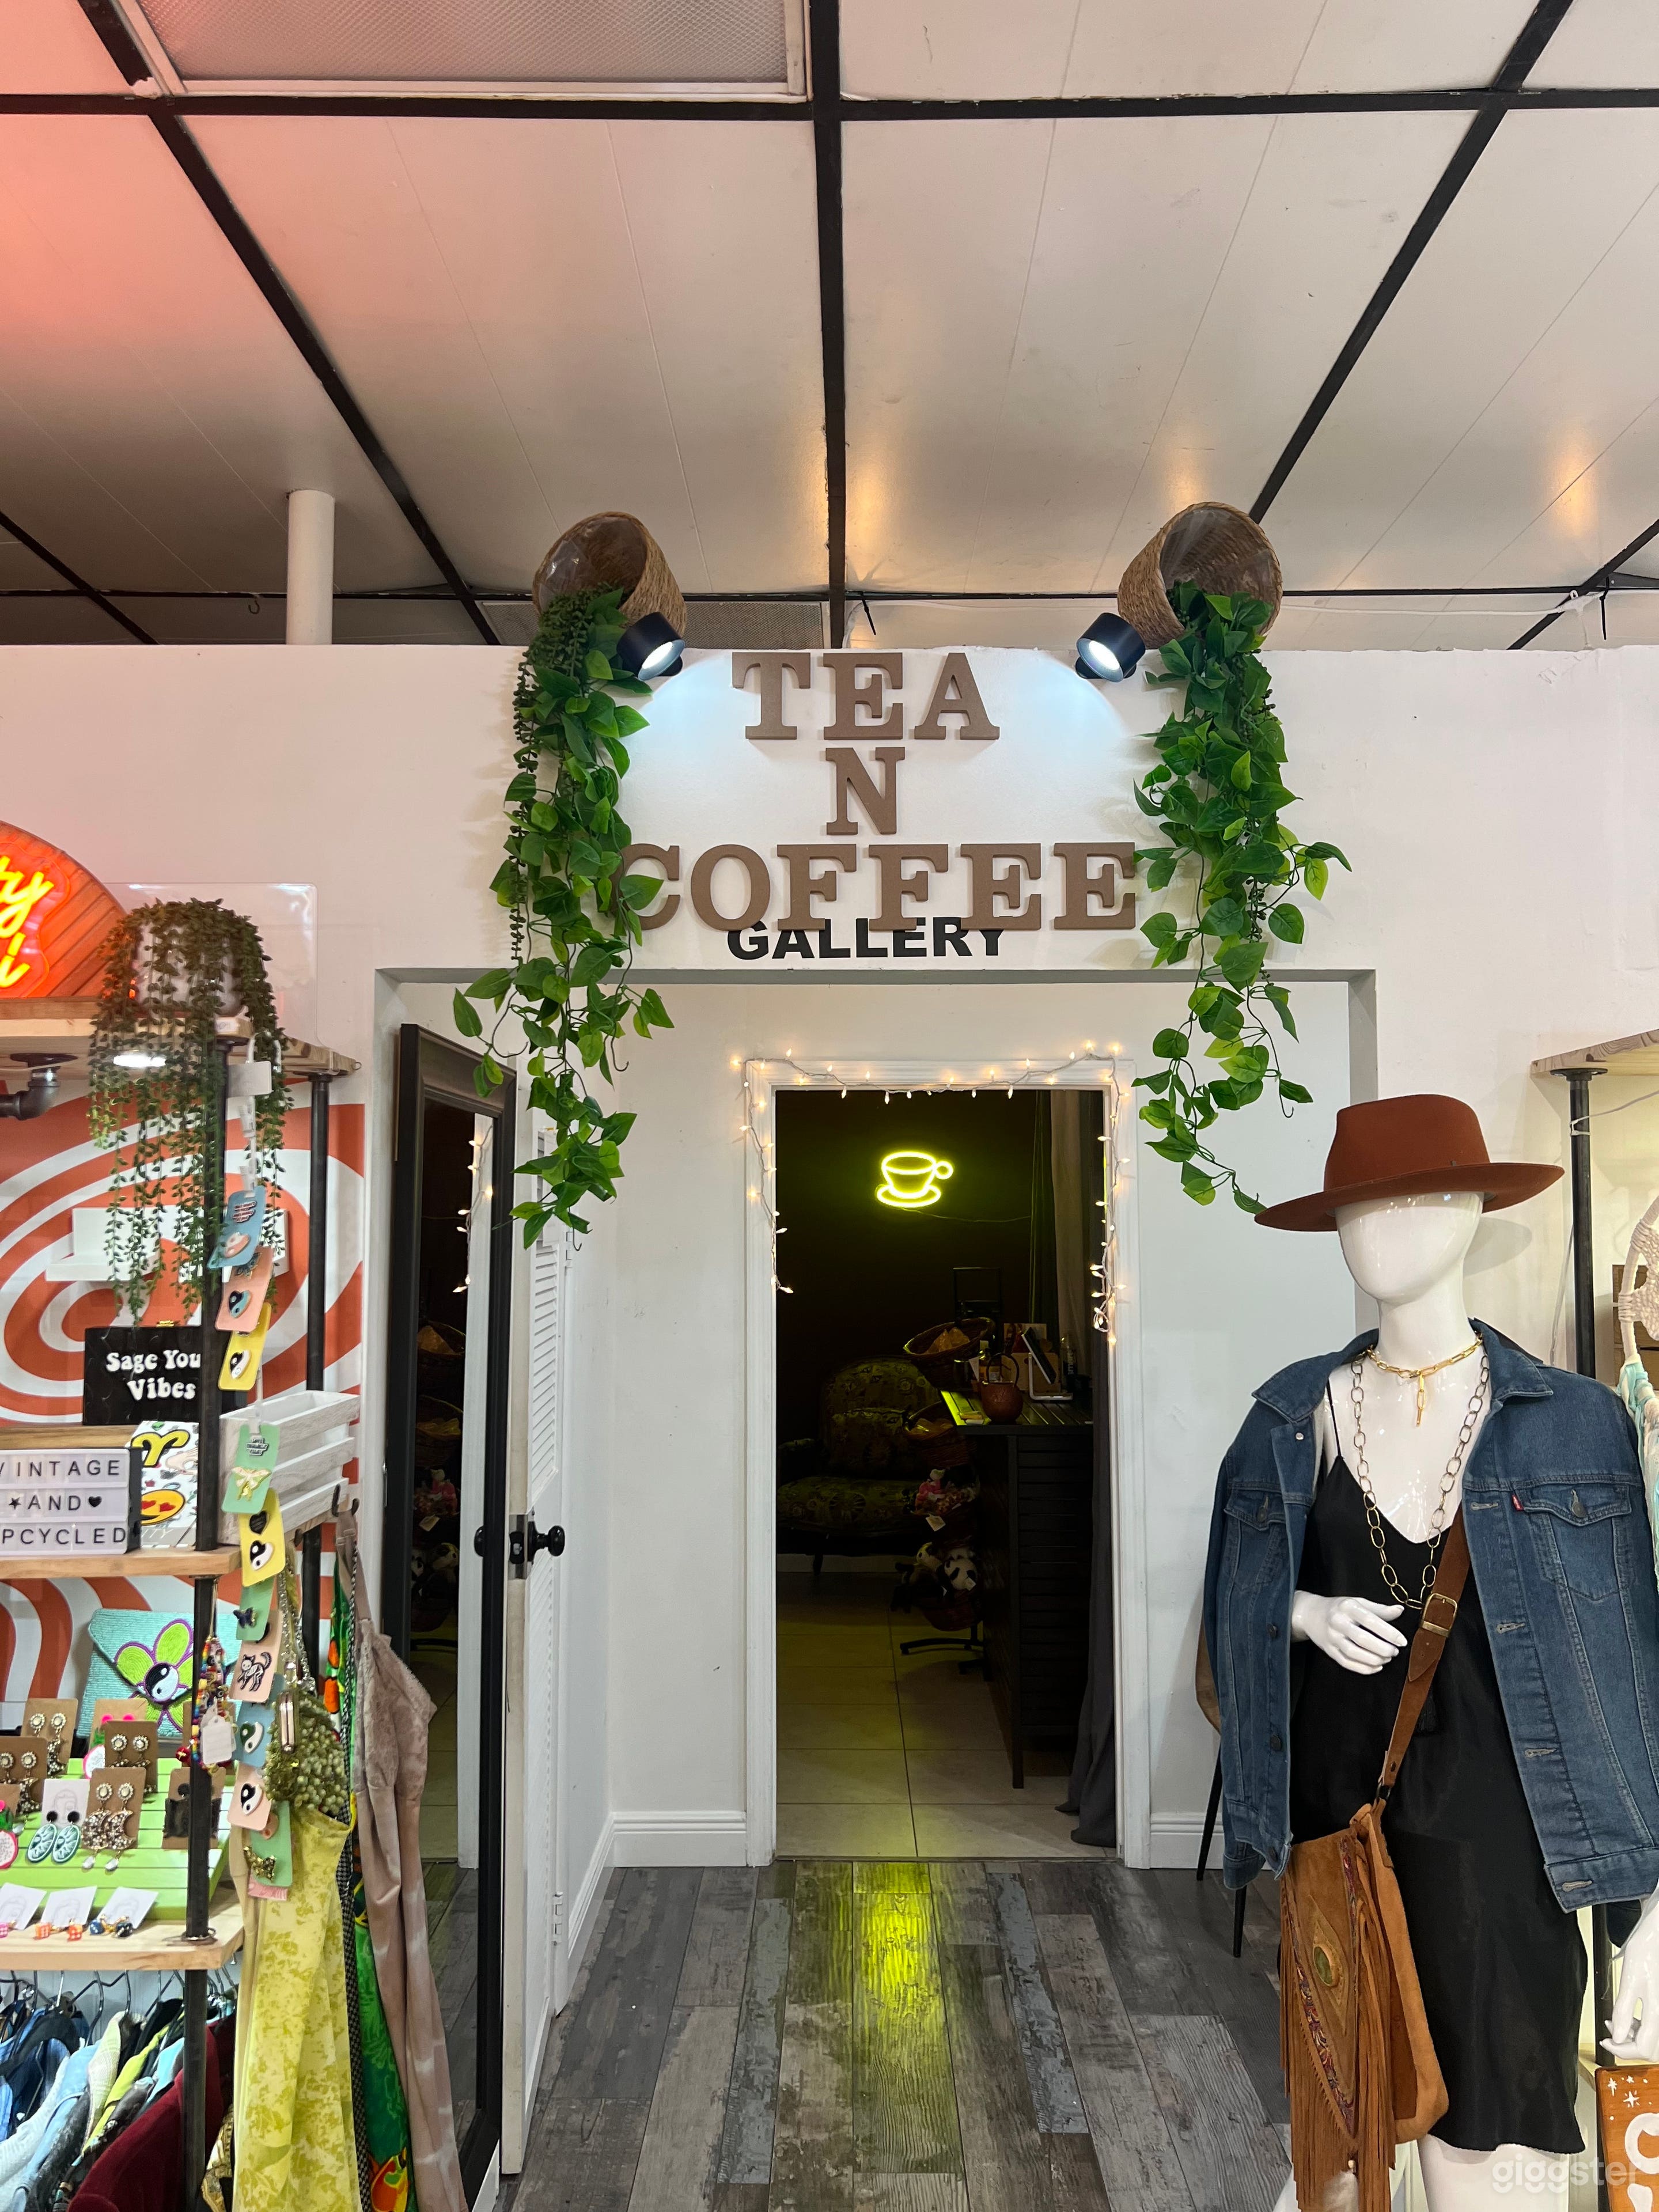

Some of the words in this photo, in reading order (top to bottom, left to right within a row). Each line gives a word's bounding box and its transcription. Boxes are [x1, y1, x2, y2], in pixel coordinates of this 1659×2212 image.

[732, 652, 999, 740] TEA
[825, 747, 904, 835] N
[609, 842, 1135, 931] COFFEE
[728, 916, 1004, 960] GALLERY
[106, 1353, 158, 1373] Sage
[163, 1350, 201, 1370] You
[127, 1377, 196, 1400] Vibes
[28, 1495, 81, 1510] AND
[2, 1528, 126, 1544] PCYCLED
